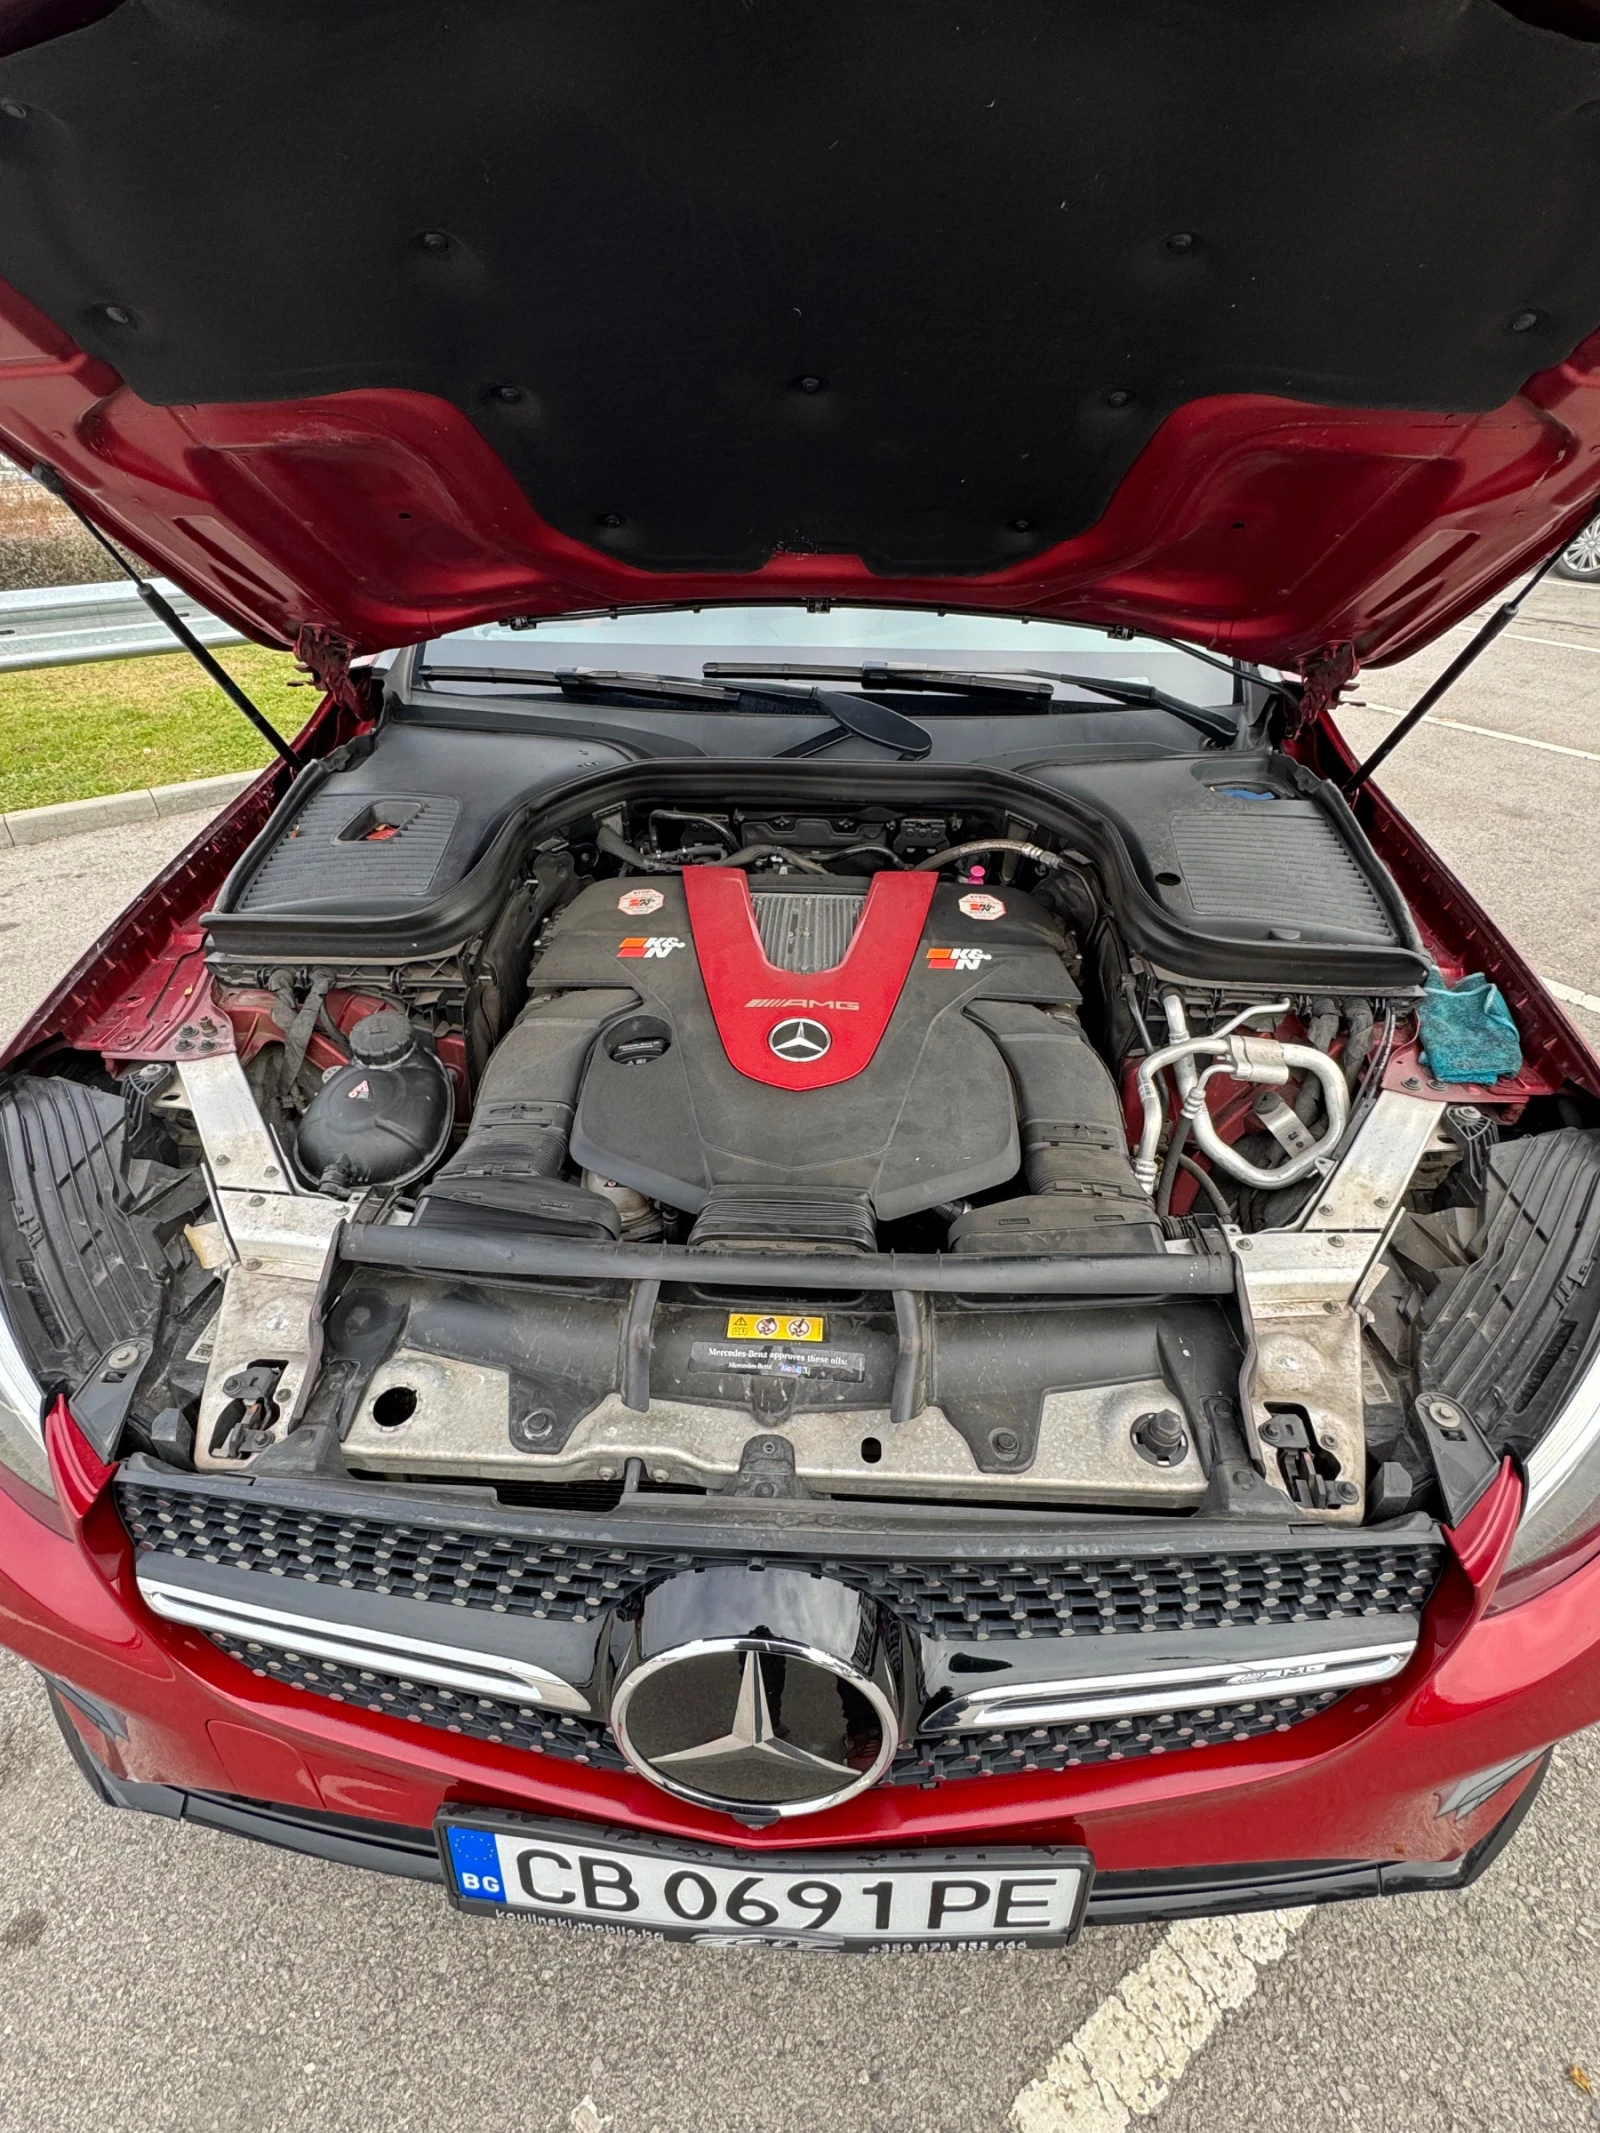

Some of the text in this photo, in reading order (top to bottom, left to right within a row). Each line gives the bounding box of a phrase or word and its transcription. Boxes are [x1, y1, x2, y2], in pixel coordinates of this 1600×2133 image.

[781, 998, 859, 1010] AMG
[708, 1347, 848, 1366] Mercedes-Benz approves these oils:
[461, 1872, 501, 1894] BG
[516, 1848, 1059, 1930] CB 0691 PE
